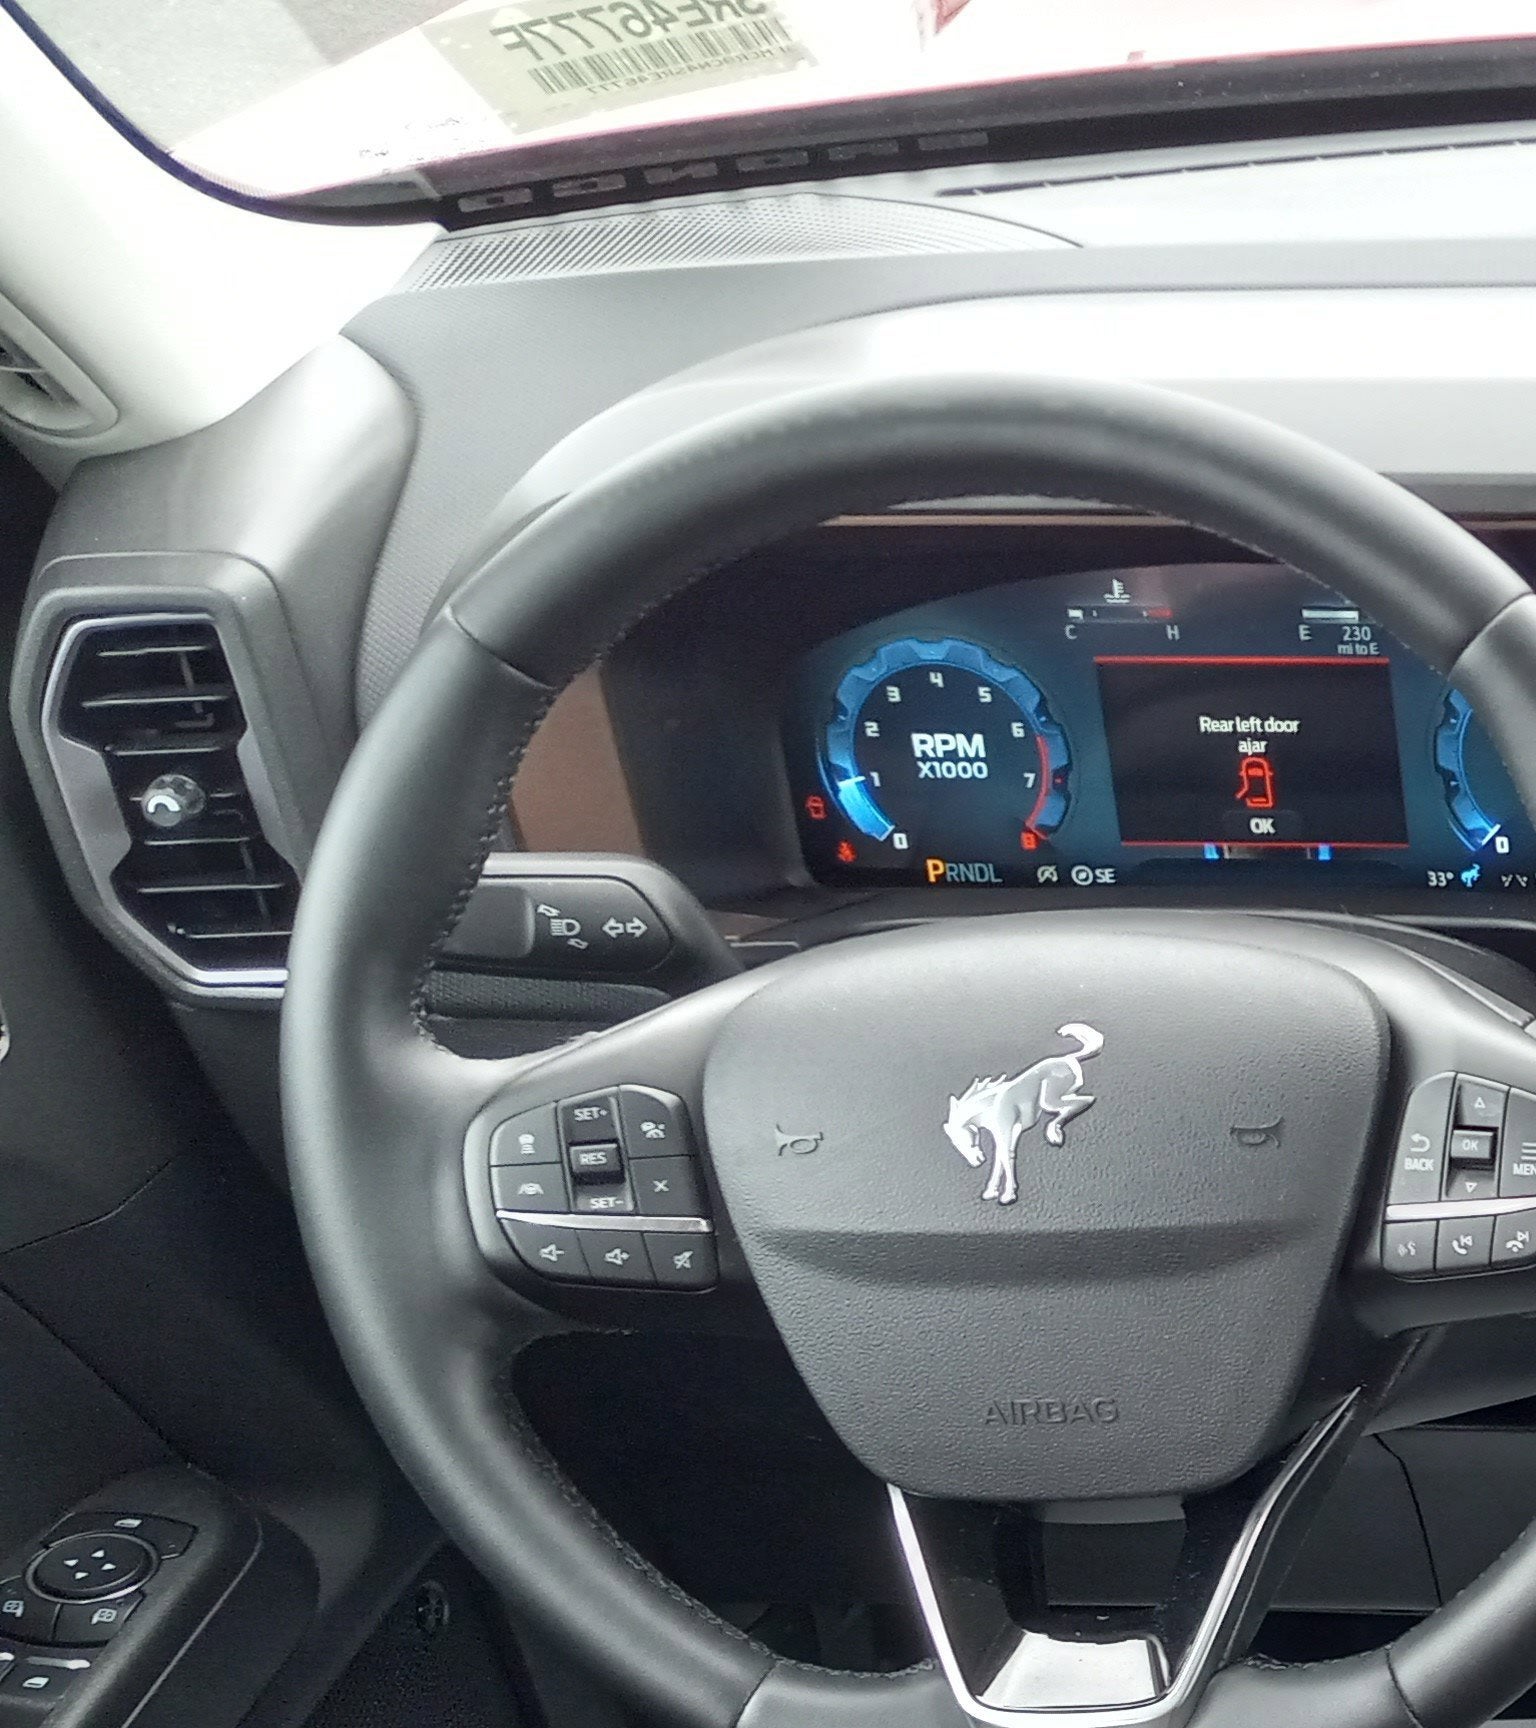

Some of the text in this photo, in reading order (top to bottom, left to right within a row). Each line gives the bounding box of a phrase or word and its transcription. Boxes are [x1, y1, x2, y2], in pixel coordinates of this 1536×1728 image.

[1342, 625, 1372, 641] 230
[1369, 643, 1380, 655] E
[930, 672, 944, 687] 4
[887, 687, 901, 702] 3
[978, 687, 992, 702] 5
[865, 722, 880, 737] 2
[1012, 722, 1025, 738] 6
[1200, 716, 1300, 733] Rear left door
[911, 733, 986, 758] RPM
[1238, 738, 1267, 755] ajar
[917, 761, 988, 779] X1000
[870, 772, 881, 787] 1
[1024, 773, 1036, 788] 7
[1250, 818, 1275, 834] OK
[893, 833, 908, 849] 0
[1021, 832, 1038, 849] 8
[1495, 837, 1510, 854] 0
[1096, 868, 1116, 883] SE
[1462, 1140, 1479, 1150] OK
[579, 1153, 607, 1165] RES
[1404, 1157, 1434, 1171] BACK
[984, 1400, 1121, 1426] AIRBAG
